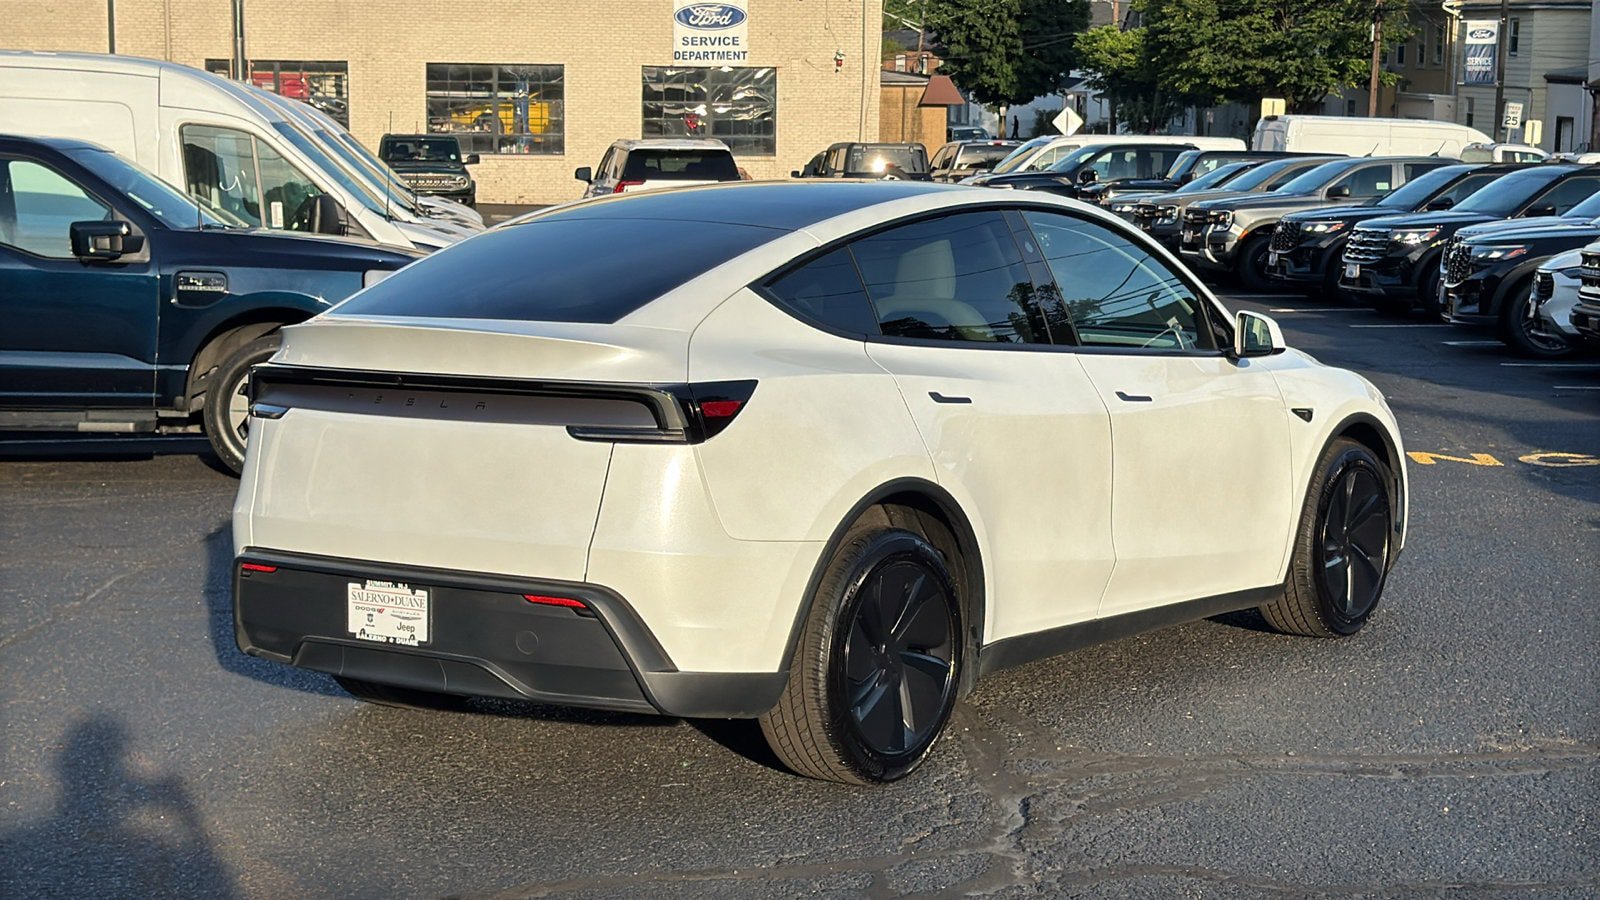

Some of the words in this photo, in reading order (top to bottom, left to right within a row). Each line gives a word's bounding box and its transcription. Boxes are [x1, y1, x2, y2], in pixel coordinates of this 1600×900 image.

[682, 36, 740, 46] SERVICE
[674, 51, 748, 61] DEPARTMENT
[1466, 56, 1492, 66] SERVICE
[1504, 115, 1518, 126] 25
[348, 393, 486, 411] TESLA
[352, 591, 390, 604] SALERNO
[395, 596, 426, 609] DUANE
[397, 622, 415, 633] Jeep
